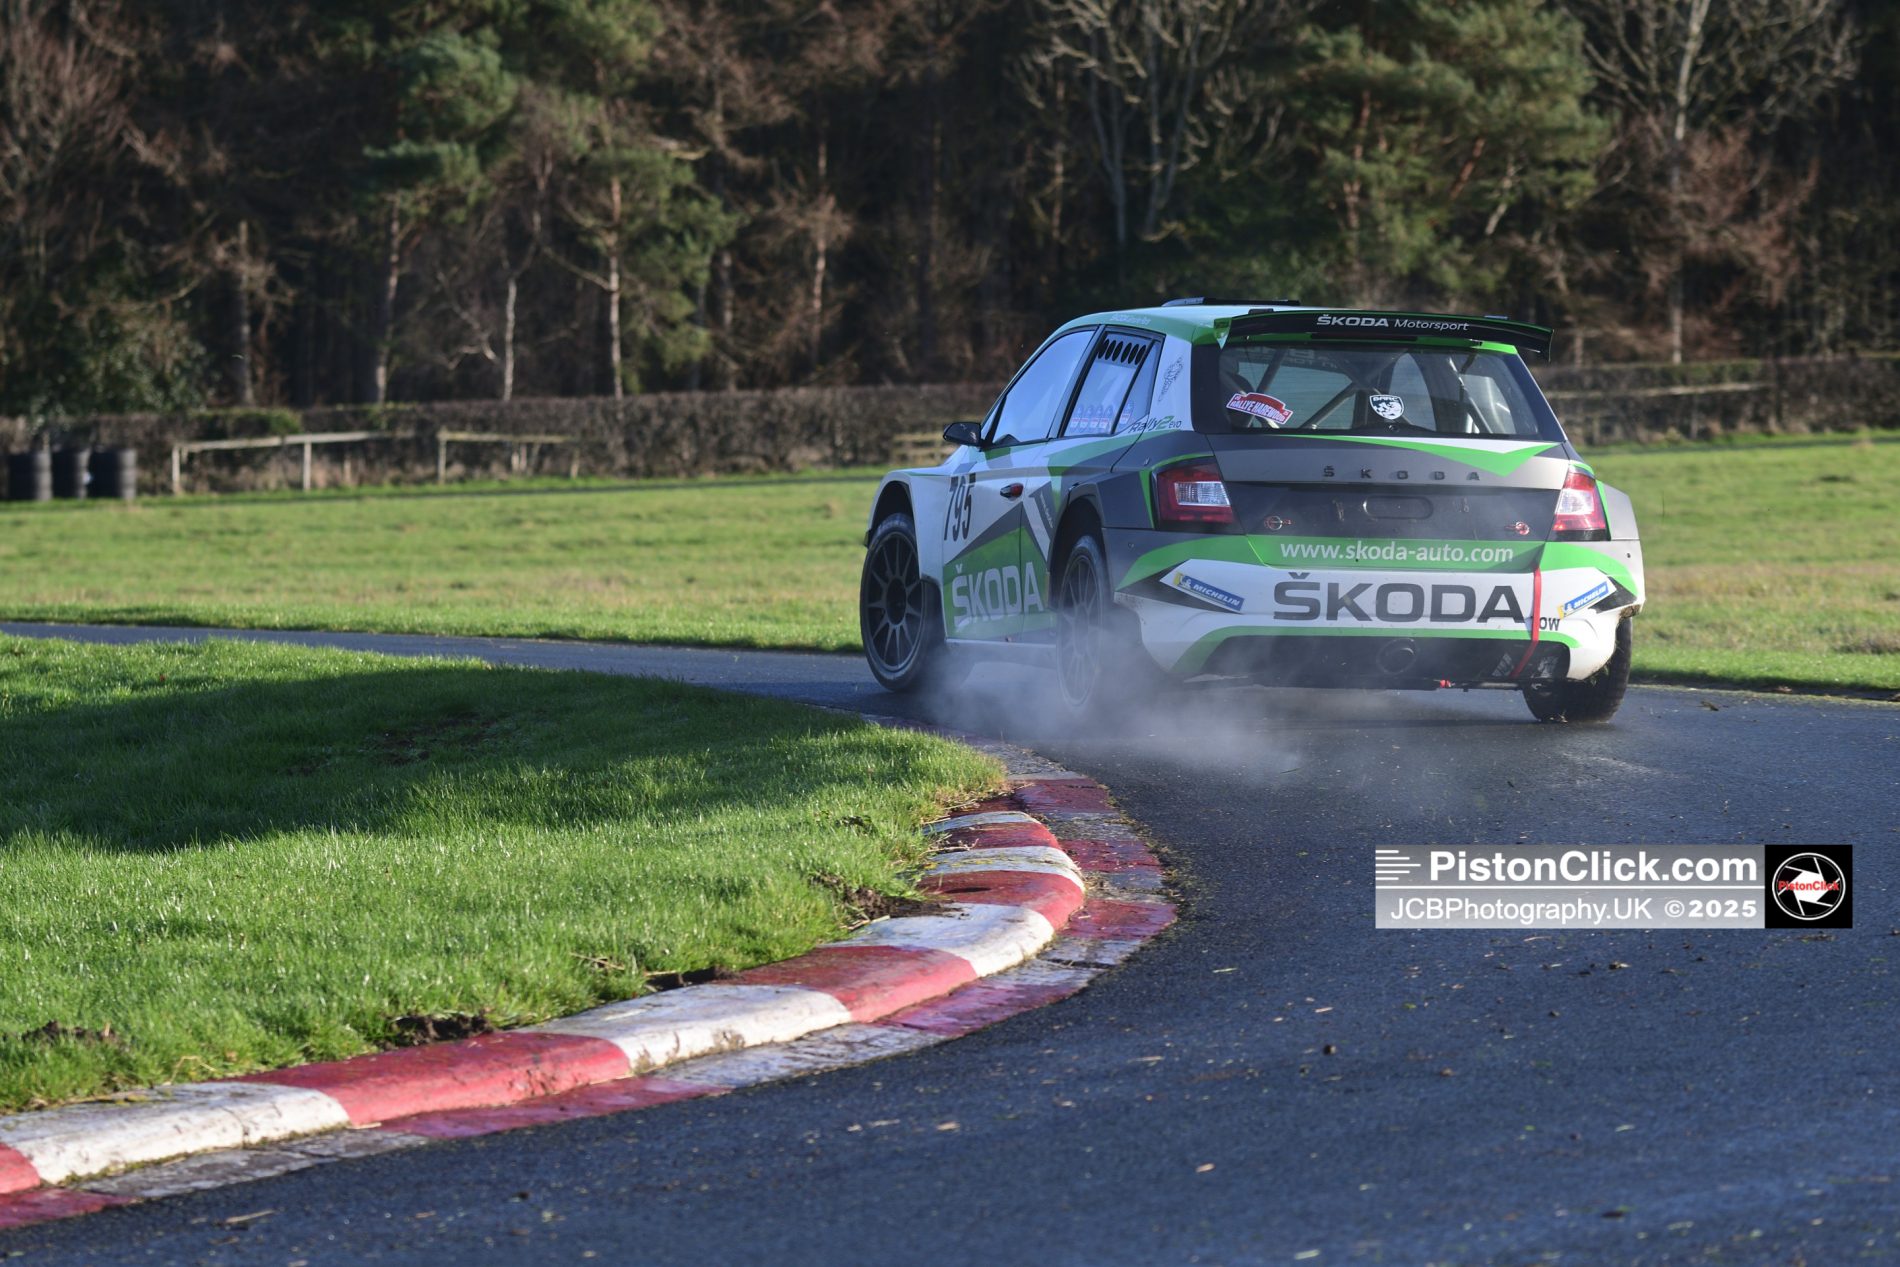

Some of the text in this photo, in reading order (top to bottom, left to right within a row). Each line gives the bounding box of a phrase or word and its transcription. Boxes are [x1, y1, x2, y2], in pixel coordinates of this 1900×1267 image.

[1316, 314, 1470, 331] ŠKODA Motorsport
[1229, 399, 1256, 411] RALLYE
[1323, 465, 1480, 481] ŠKODA
[944, 473, 976, 541] 795
[1280, 541, 1514, 562] www.skoda-auto.com
[952, 562, 1045, 628] ŠKODA
[1193, 584, 1241, 606] MICHELIN
[1273, 572, 1526, 624] ŠKODA
[1533, 616, 1561, 631] OW
